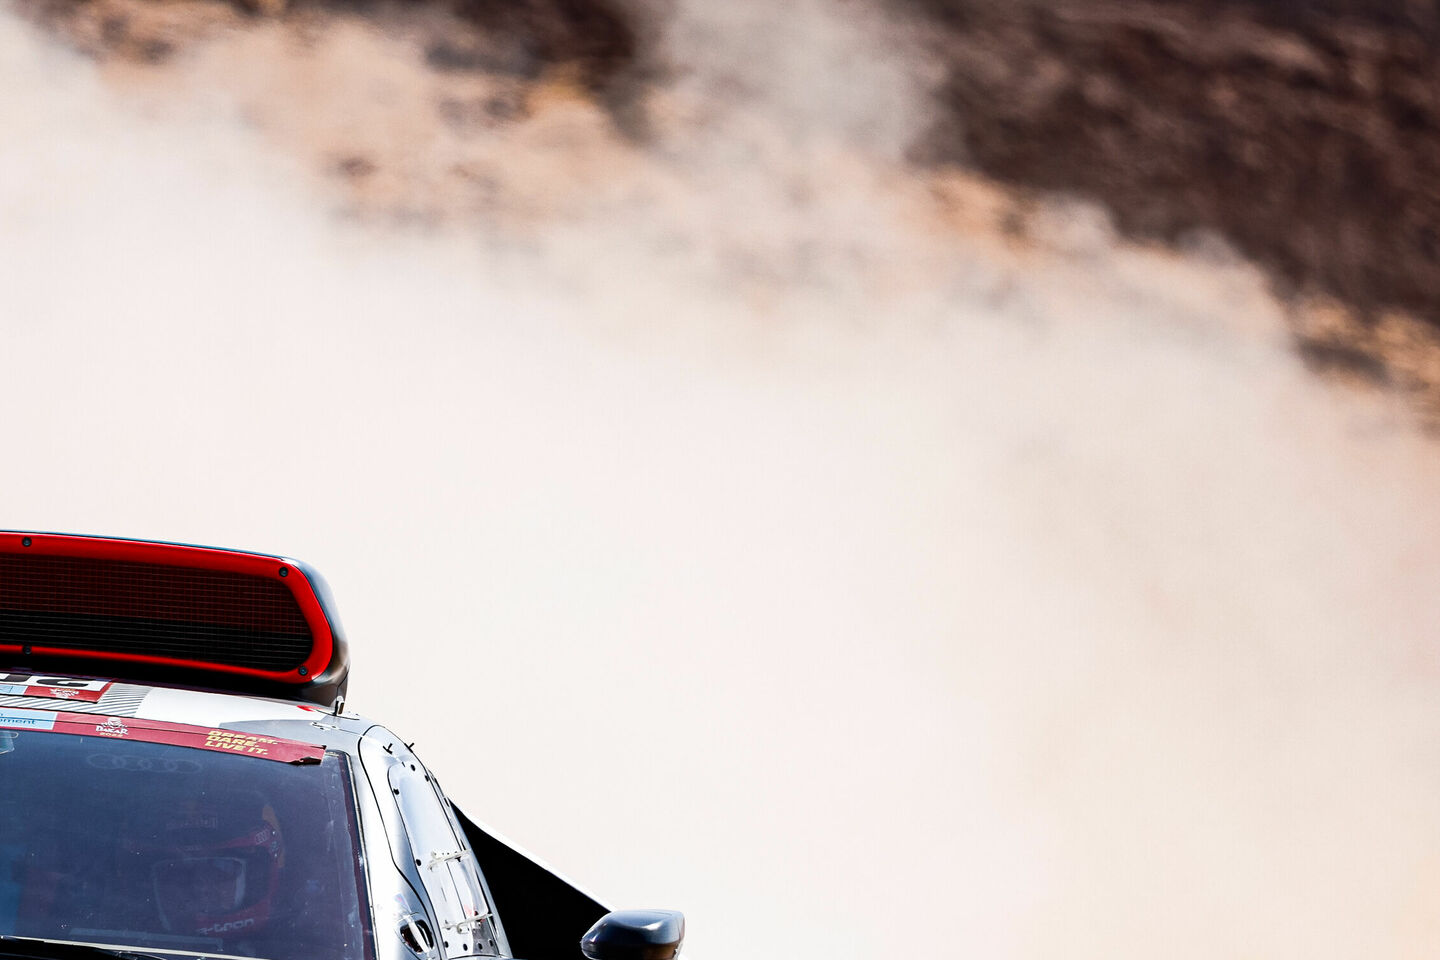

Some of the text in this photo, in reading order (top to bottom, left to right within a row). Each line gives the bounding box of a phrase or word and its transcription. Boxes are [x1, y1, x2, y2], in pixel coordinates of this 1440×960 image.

[95, 725, 129, 736] DAKAR
[204, 741, 246, 751] LIVE
[206, 735, 260, 748] DARE.
